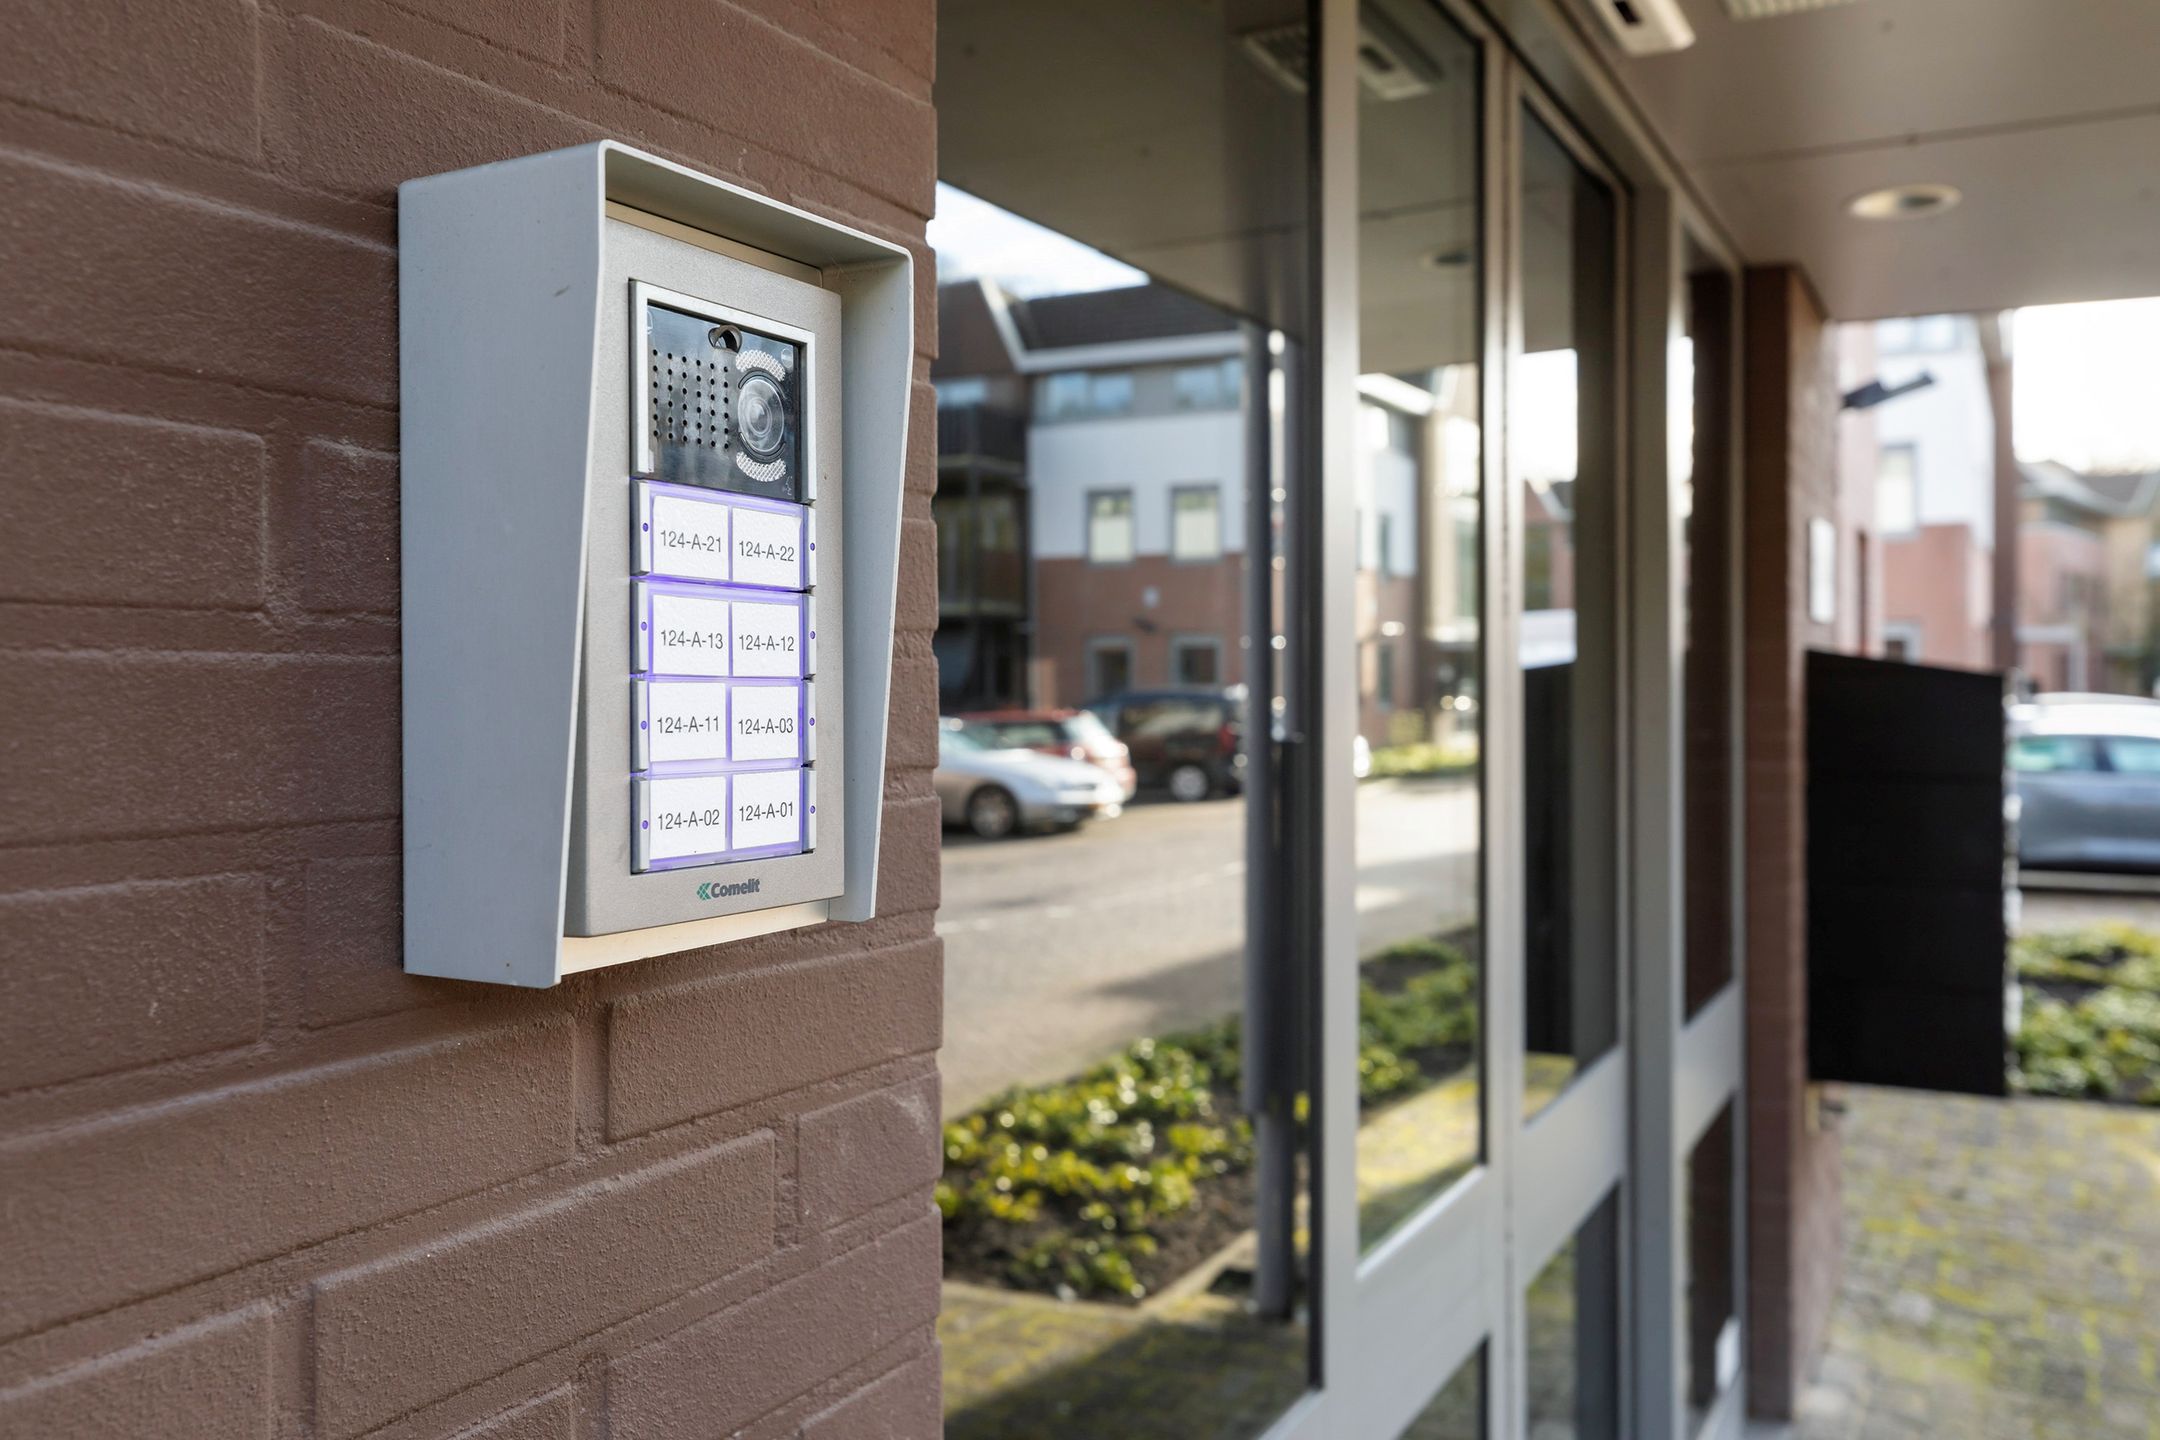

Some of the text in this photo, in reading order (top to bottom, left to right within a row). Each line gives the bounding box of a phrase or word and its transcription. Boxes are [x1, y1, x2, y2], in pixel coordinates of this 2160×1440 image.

[660, 530, 721, 553] 124-A-21
[738, 540, 795, 562] 124-A-22
[660, 629, 724, 650] 124-A-13
[738, 634, 795, 651] 124-A-12
[656, 716, 719, 734] 124-A-11
[738, 717, 794, 735] 124-A-03
[657, 809, 720, 830] 124-A-02
[738, 801, 794, 822] 124-A-01
[710, 878, 761, 898] Comelit
